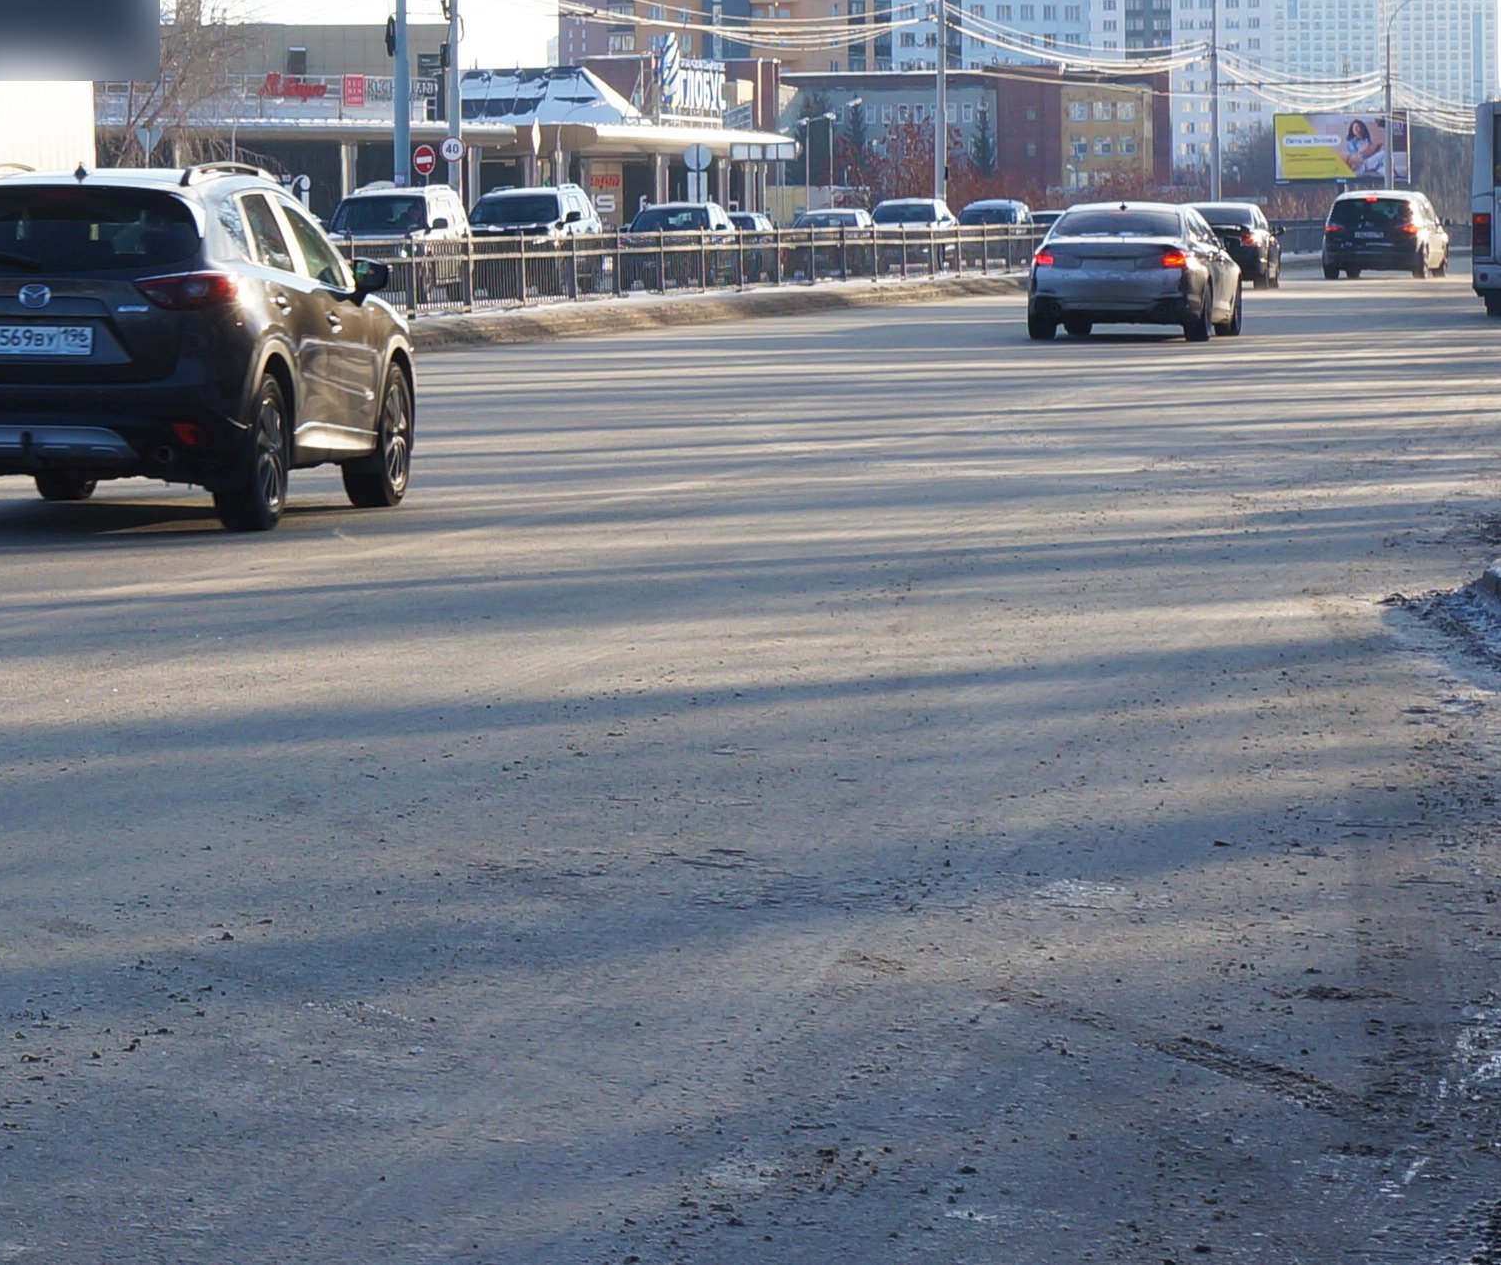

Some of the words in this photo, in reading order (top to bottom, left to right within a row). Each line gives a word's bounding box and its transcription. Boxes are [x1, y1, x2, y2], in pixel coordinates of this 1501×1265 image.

[678, 69, 727, 111] ГЛОБУС
[445, 143, 459, 154] 40
[61, 328, 89, 343] 196
